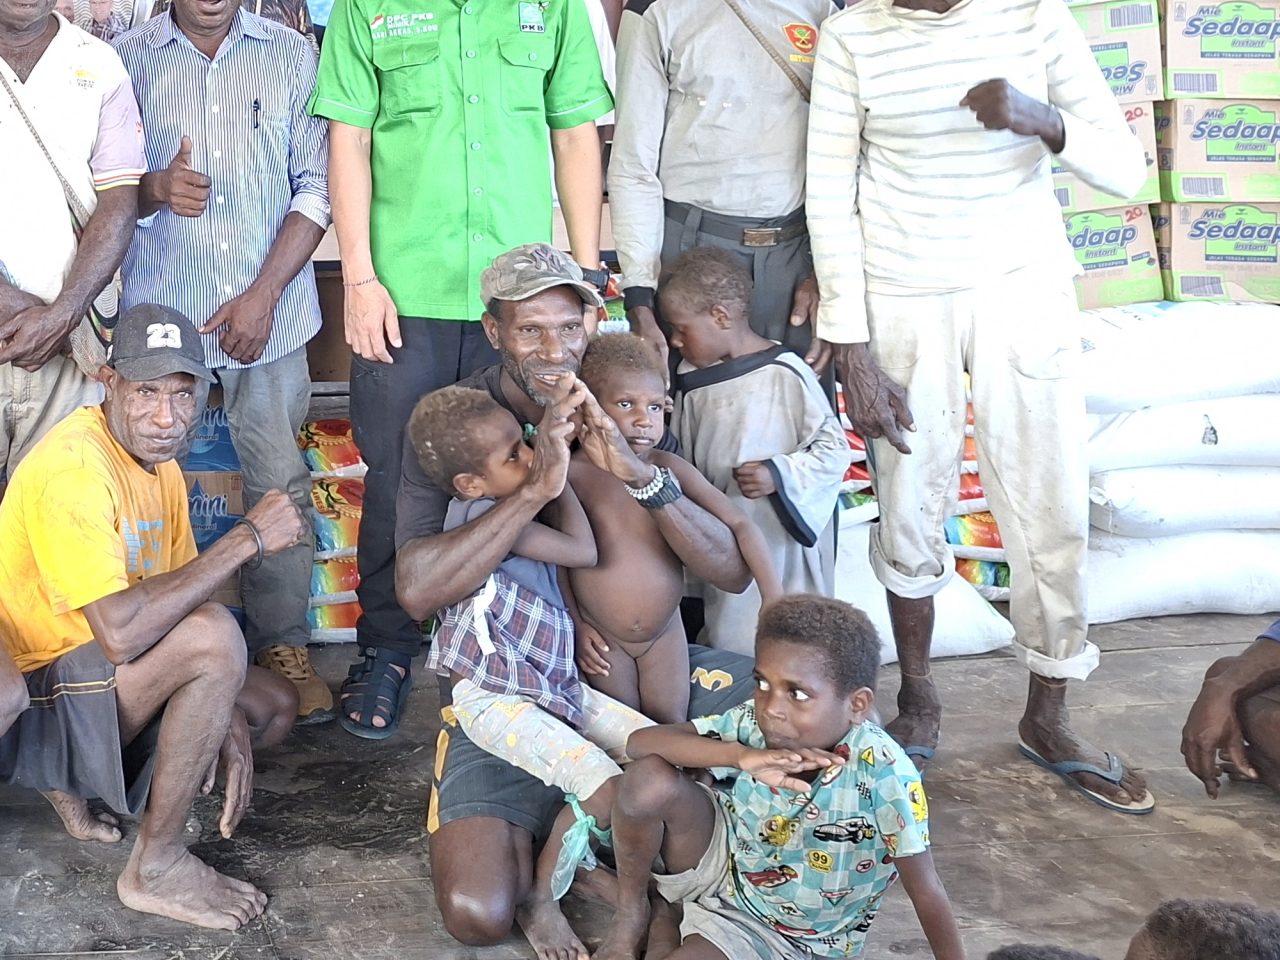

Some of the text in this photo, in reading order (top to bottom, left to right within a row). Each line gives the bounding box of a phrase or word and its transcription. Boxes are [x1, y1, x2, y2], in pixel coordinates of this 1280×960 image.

[1199, 8, 1221, 16] Mie
[387, 13, 434, 23] DPC PKB
[1205, 111, 1226, 119] Mie
[1203, 210, 1226, 219] Mie
[1072, 227, 1137, 247] daap
[147, 323, 182, 349] 23
[811, 852, 828, 865] 99
